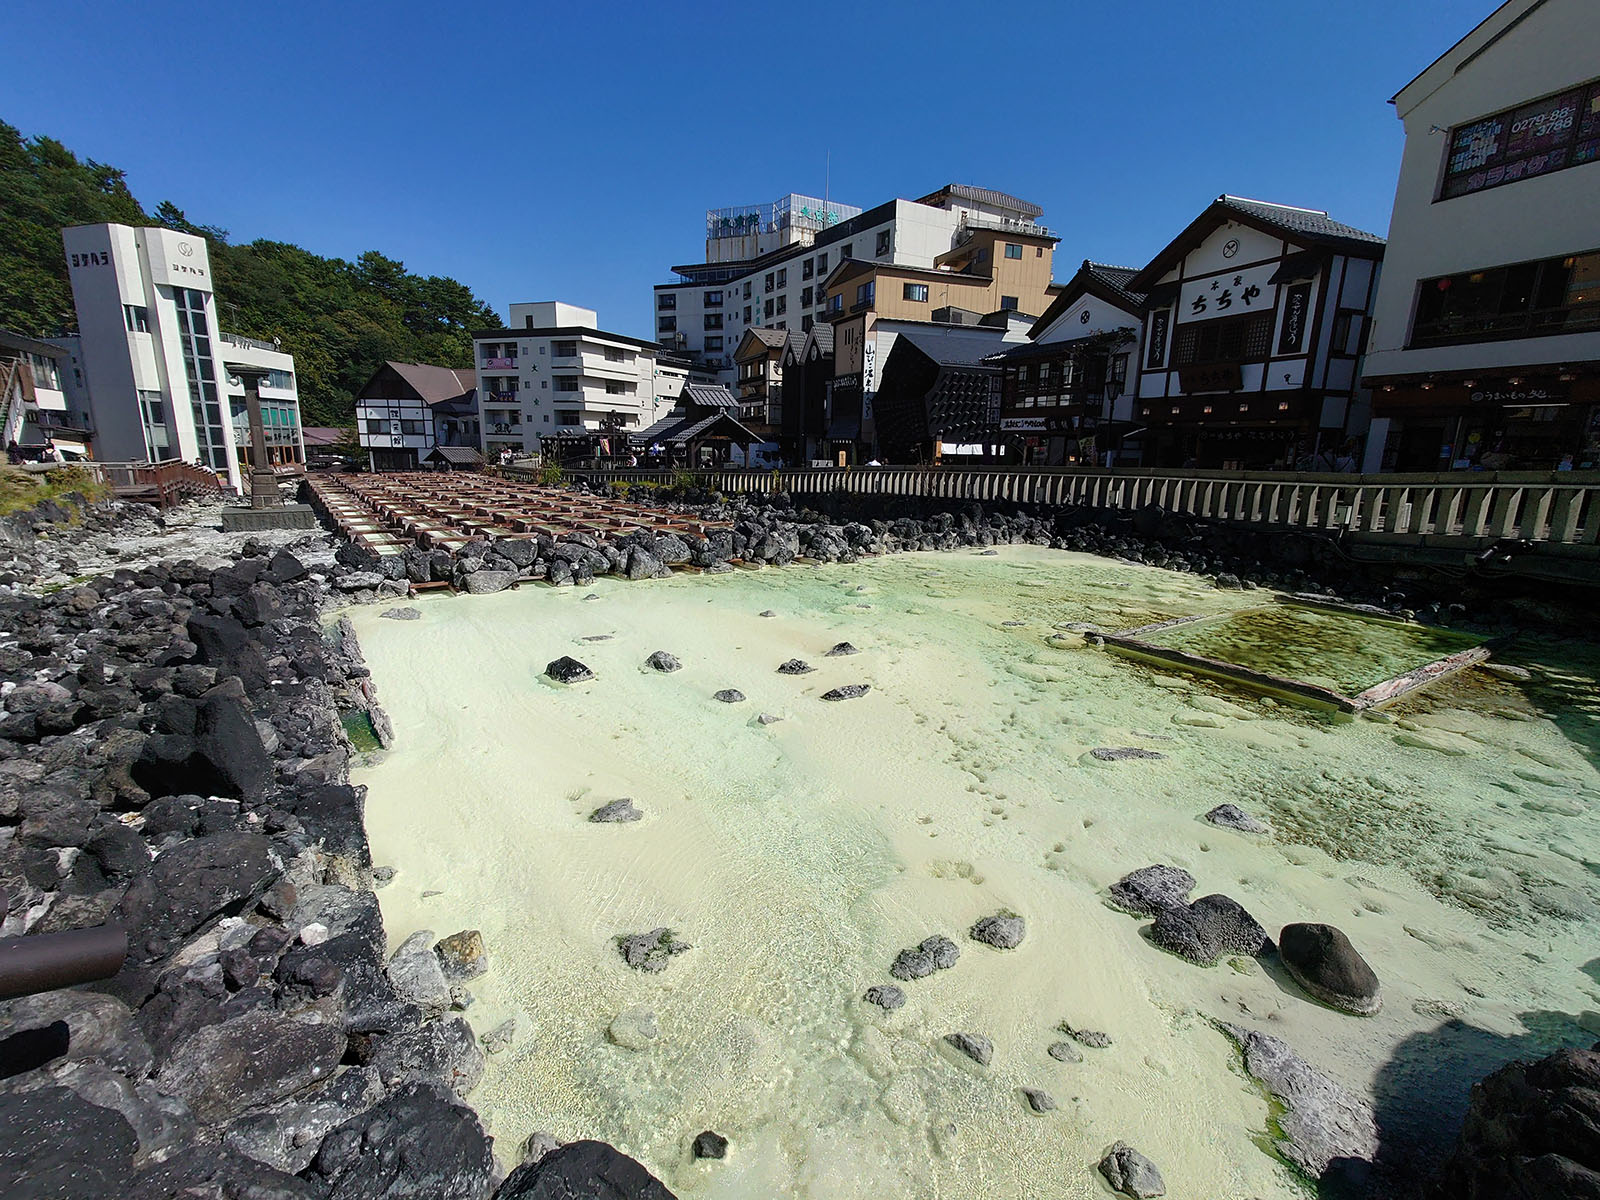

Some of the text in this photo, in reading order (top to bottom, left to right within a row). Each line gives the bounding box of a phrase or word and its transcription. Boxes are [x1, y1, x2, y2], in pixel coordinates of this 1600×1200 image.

[1511, 107, 1576, 133] 0279-88-
[1535, 116, 1574, 137] 3788
[1210, 275, 1242, 291] 本家
[1191, 285, 1260, 316] ちちや
